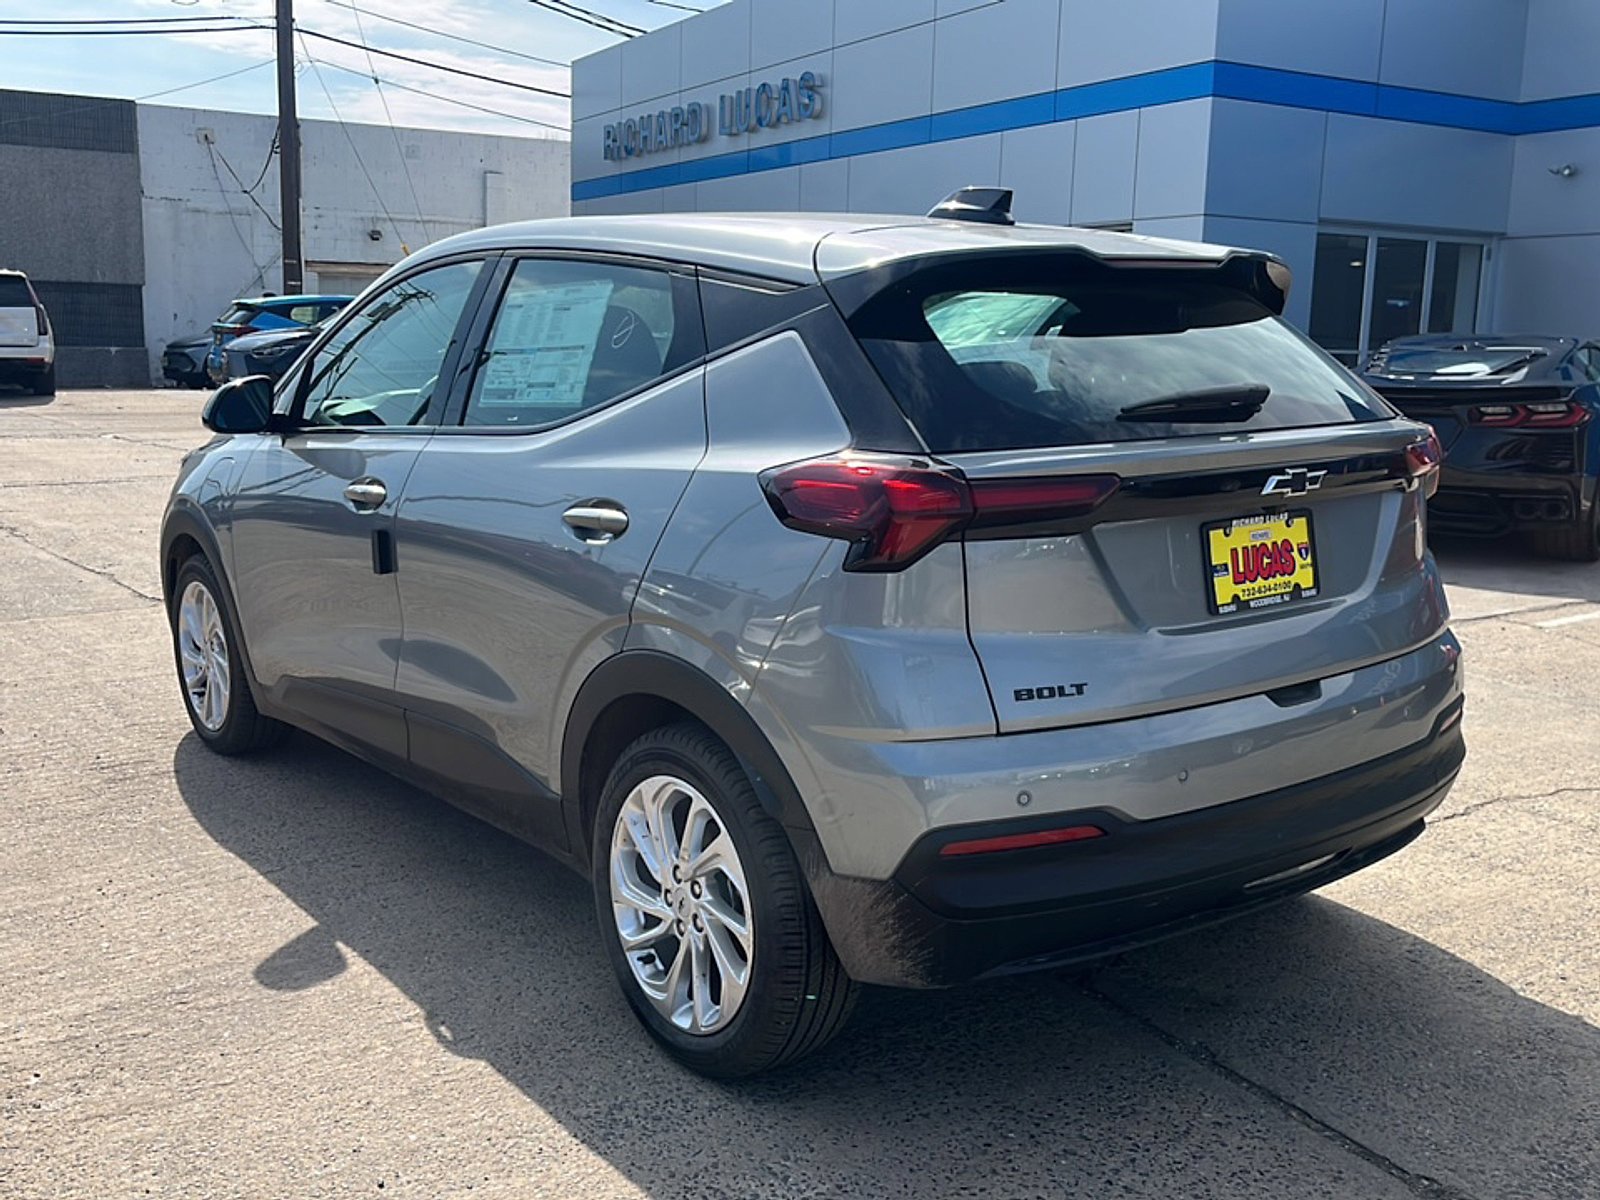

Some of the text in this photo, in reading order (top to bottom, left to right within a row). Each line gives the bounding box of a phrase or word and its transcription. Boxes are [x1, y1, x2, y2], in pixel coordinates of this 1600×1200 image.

[603, 71, 821, 161] RICHARD LUCAS
[1230, 538, 1296, 585] LUCAS
[1013, 682, 1089, 702] BOLT
